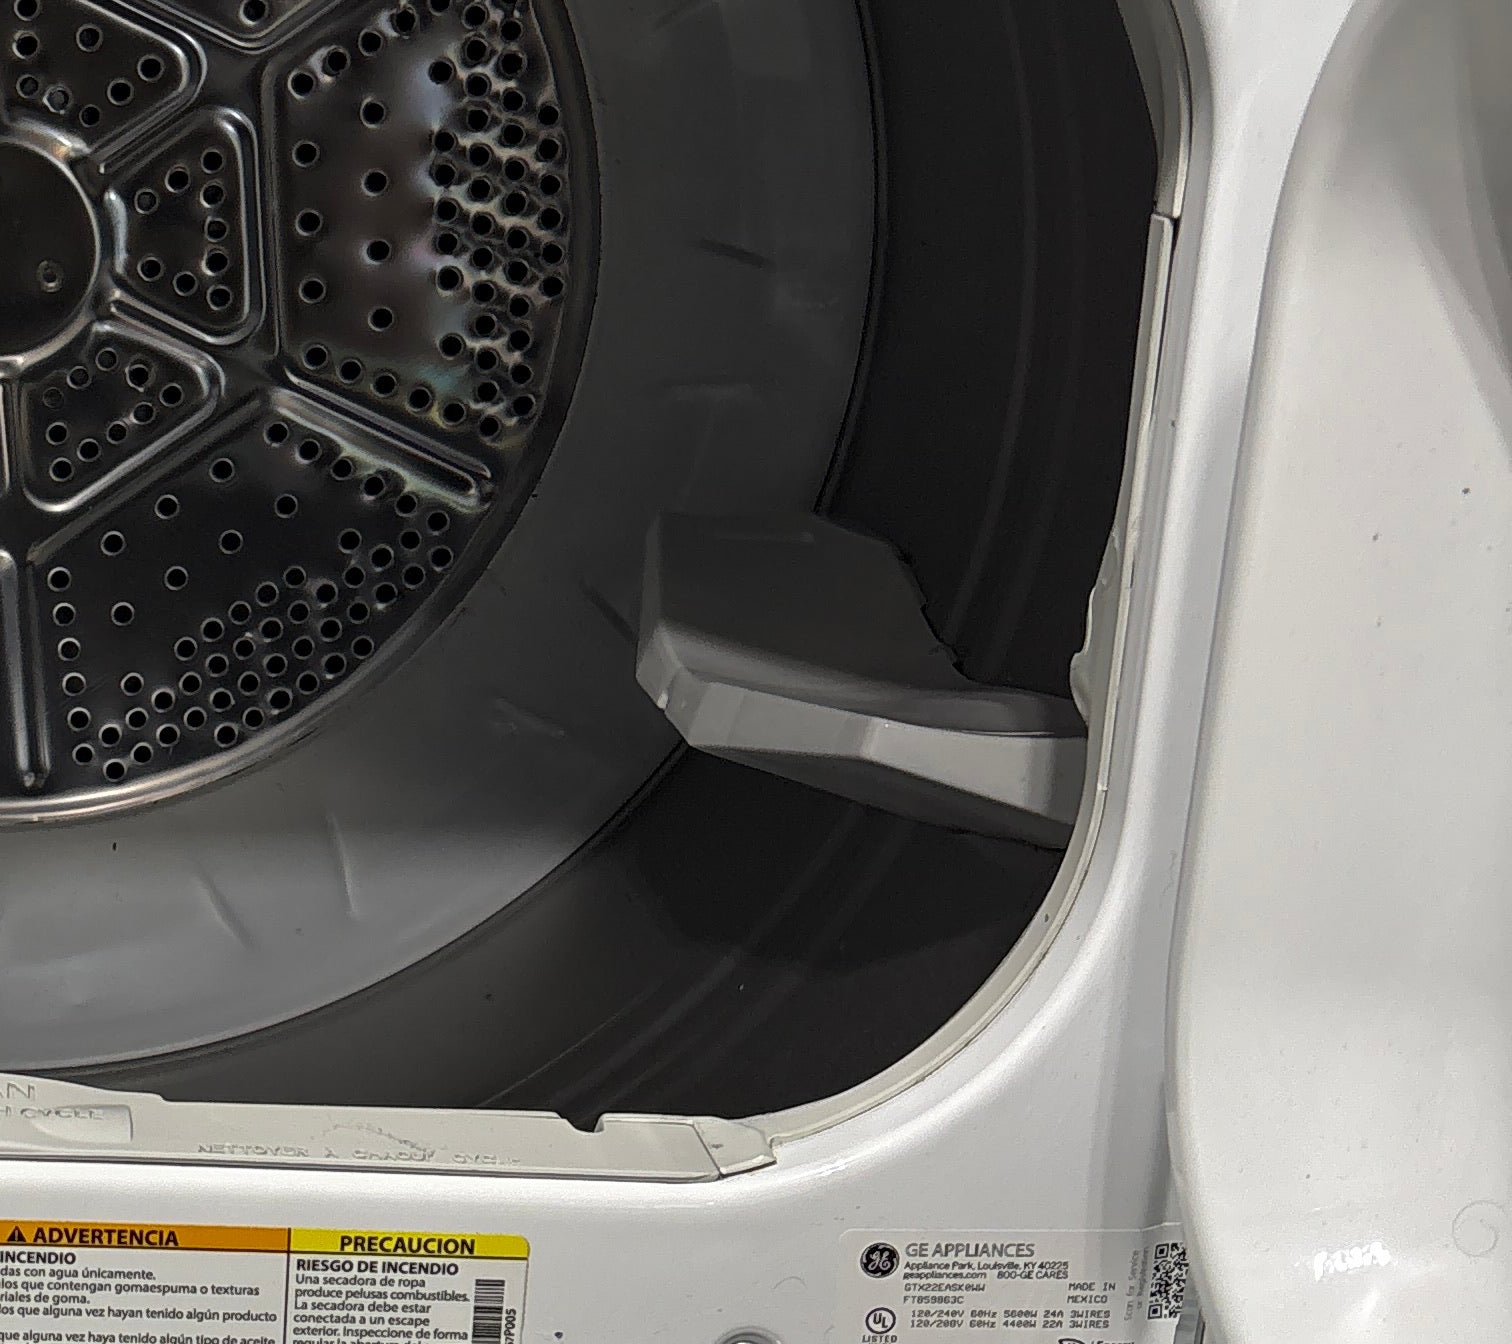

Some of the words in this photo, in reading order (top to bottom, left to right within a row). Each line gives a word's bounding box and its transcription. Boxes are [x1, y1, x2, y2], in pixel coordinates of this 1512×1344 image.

[20, 1107, 104, 1121] CYCLE
[32, 1227, 178, 1246] ADVERTENCIA
[340, 1236, 476, 1254] PRECAUCION
[905, 1243, 929, 1257] GE
[932, 1243, 1035, 1257] APPLIANCES
[0, 1251, 76, 1264] INCENDIO
[296, 1259, 353, 1272] RIESGO
[356, 1261, 377, 1273] DE
[381, 1262, 458, 1275] INCENDIO
[904, 1261, 950, 1271] Appliance
[1024, 1262, 1037, 1270] KY
[1038, 1261, 1068, 1270] 40225
[23, 1268, 45, 1277] con
[48, 1269, 78, 1281] agua
[81, 1268, 156, 1280] únicamente.
[903, 1271, 987, 1280] geappliances.com
[997, 1271, 1033, 1279] 800-GE
[1036, 1271, 1068, 1279] CARES
[20, 1281, 44, 1293] que
[46, 1280, 111, 1294] contengan
[114, 1283, 197, 1297] gomaespuma
[199, 1285, 208, 1294] o
[210, 1284, 260, 1295] texturas
[296, 1274, 319, 1285] Una
[322, 1274, 376, 1286] secadora
[379, 1276, 395, 1287] de
[397, 1278, 426, 1290] ropa
[1068, 1283, 1096, 1291] MADE
[1103, 1282, 1116, 1291] IN
[294, 1286, 342, 1301] produce
[345, 1288, 387, 1302] pelusas
[390, 1289, 470, 1301] combustibles.
[1067, 1295, 1108, 1304] MEXICO
[294, 1299, 308, 1310] La
[310, 1300, 364, 1311] secadora
[367, 1301, 398, 1312] debe
[401, 1303, 432, 1313] estar
[1070, 1310, 1110, 1318] 3WIRES
[1069, 1320, 1109, 1328] 3WIRES
[862, 1335, 898, 1343] LISTED
